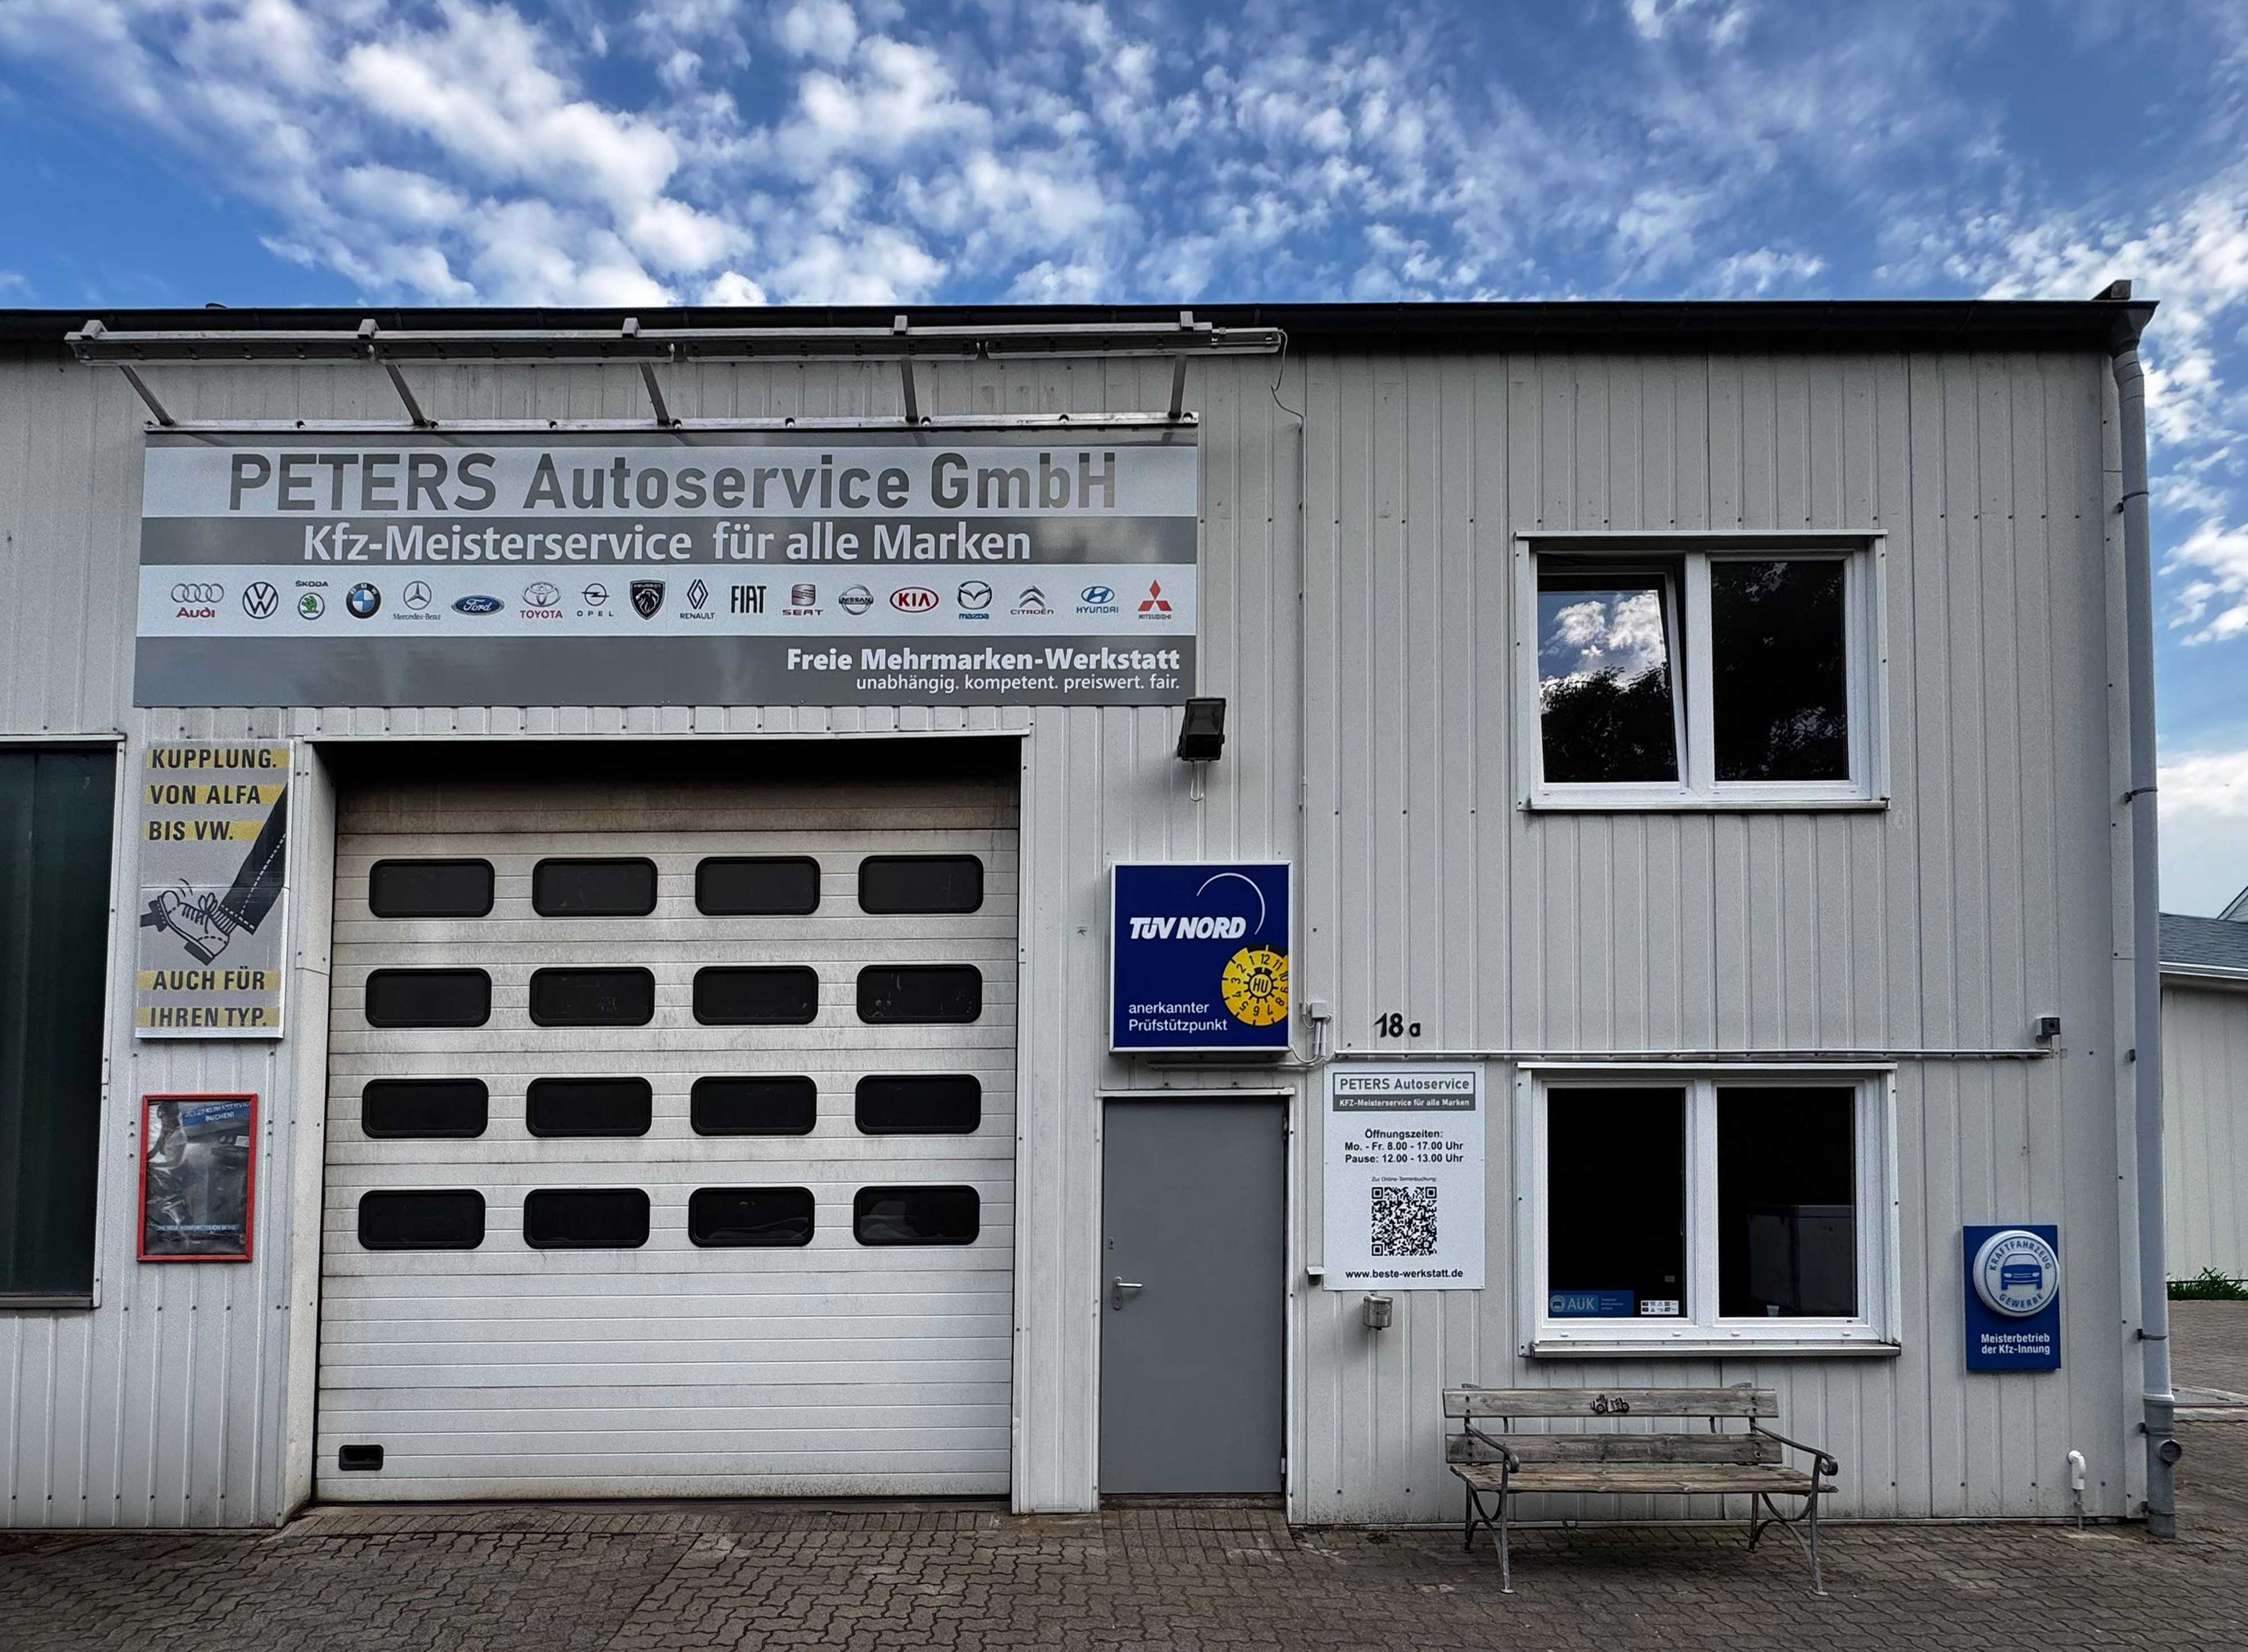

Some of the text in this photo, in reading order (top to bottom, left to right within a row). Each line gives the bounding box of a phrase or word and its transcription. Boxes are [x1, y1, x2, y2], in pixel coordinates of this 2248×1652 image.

[229, 452, 1116, 511] PETERS Autoservice GmbH
[304, 522, 1031, 561] Kfz-Meisterservice für alle Marken
[349, 583, 378, 595] BMW
[463, 599, 492, 612] Ford
[730, 585, 767, 614] FIAT
[898, 592, 931, 607] KIA
[175, 607, 216, 618] Audi
[520, 609, 564, 619] TOYOTA
[788, 647, 1180, 671] Freie Mehrmarken-Werkstatt
[856, 674, 1180, 693] unabhängig. kompetent. preiswert. fair.
[152, 748, 278, 769] KUPPLUNG.
[150, 785, 261, 805] VON ALFA
[148, 821, 234, 840] BIS VW.
[1175, 916, 1246, 939] NORD
[1261, 953, 1270, 965] 12
[152, 965, 265, 991] AUCH FÜR
[1253, 977, 1269, 993] HU
[1128, 1001, 1210, 1014] anerkannter
[150, 1007, 267, 1027] IHREN TYP.
[1128, 1018, 1228, 1034] Prüfstützpunkt
[1339, 1078, 1470, 1090] PETERS Autoservice
[1364, 1128, 1443, 1141] Öffnungszeiten:
[1345, 1141, 1363, 1151] Mo.
[1371, 1141, 1384, 1151] Fr.
[1387, 1141, 1408, 1151] 8.00
[1418, 1141, 1443, 1151] 17.00
[1445, 1141, 1464, 1150] Uhr
[1345, 1154, 1379, 1163] Pause:
[1382, 1154, 1408, 1163] 12.00
[1417, 1154, 1443, 1162] 13.00
[1445, 1153, 1464, 1162] Uhr
[1989, 1240, 2052, 1271] KRAFTFAHRZEUG
[1345, 1269, 1464, 1278] www.beste-werkstatt.de
[1999, 1293, 2044, 1308] GEWERBE
[1981, 1333, 2050, 1343] Meisterbetrieb
[1981, 1344, 2050, 1355] der Kfz-Innung
